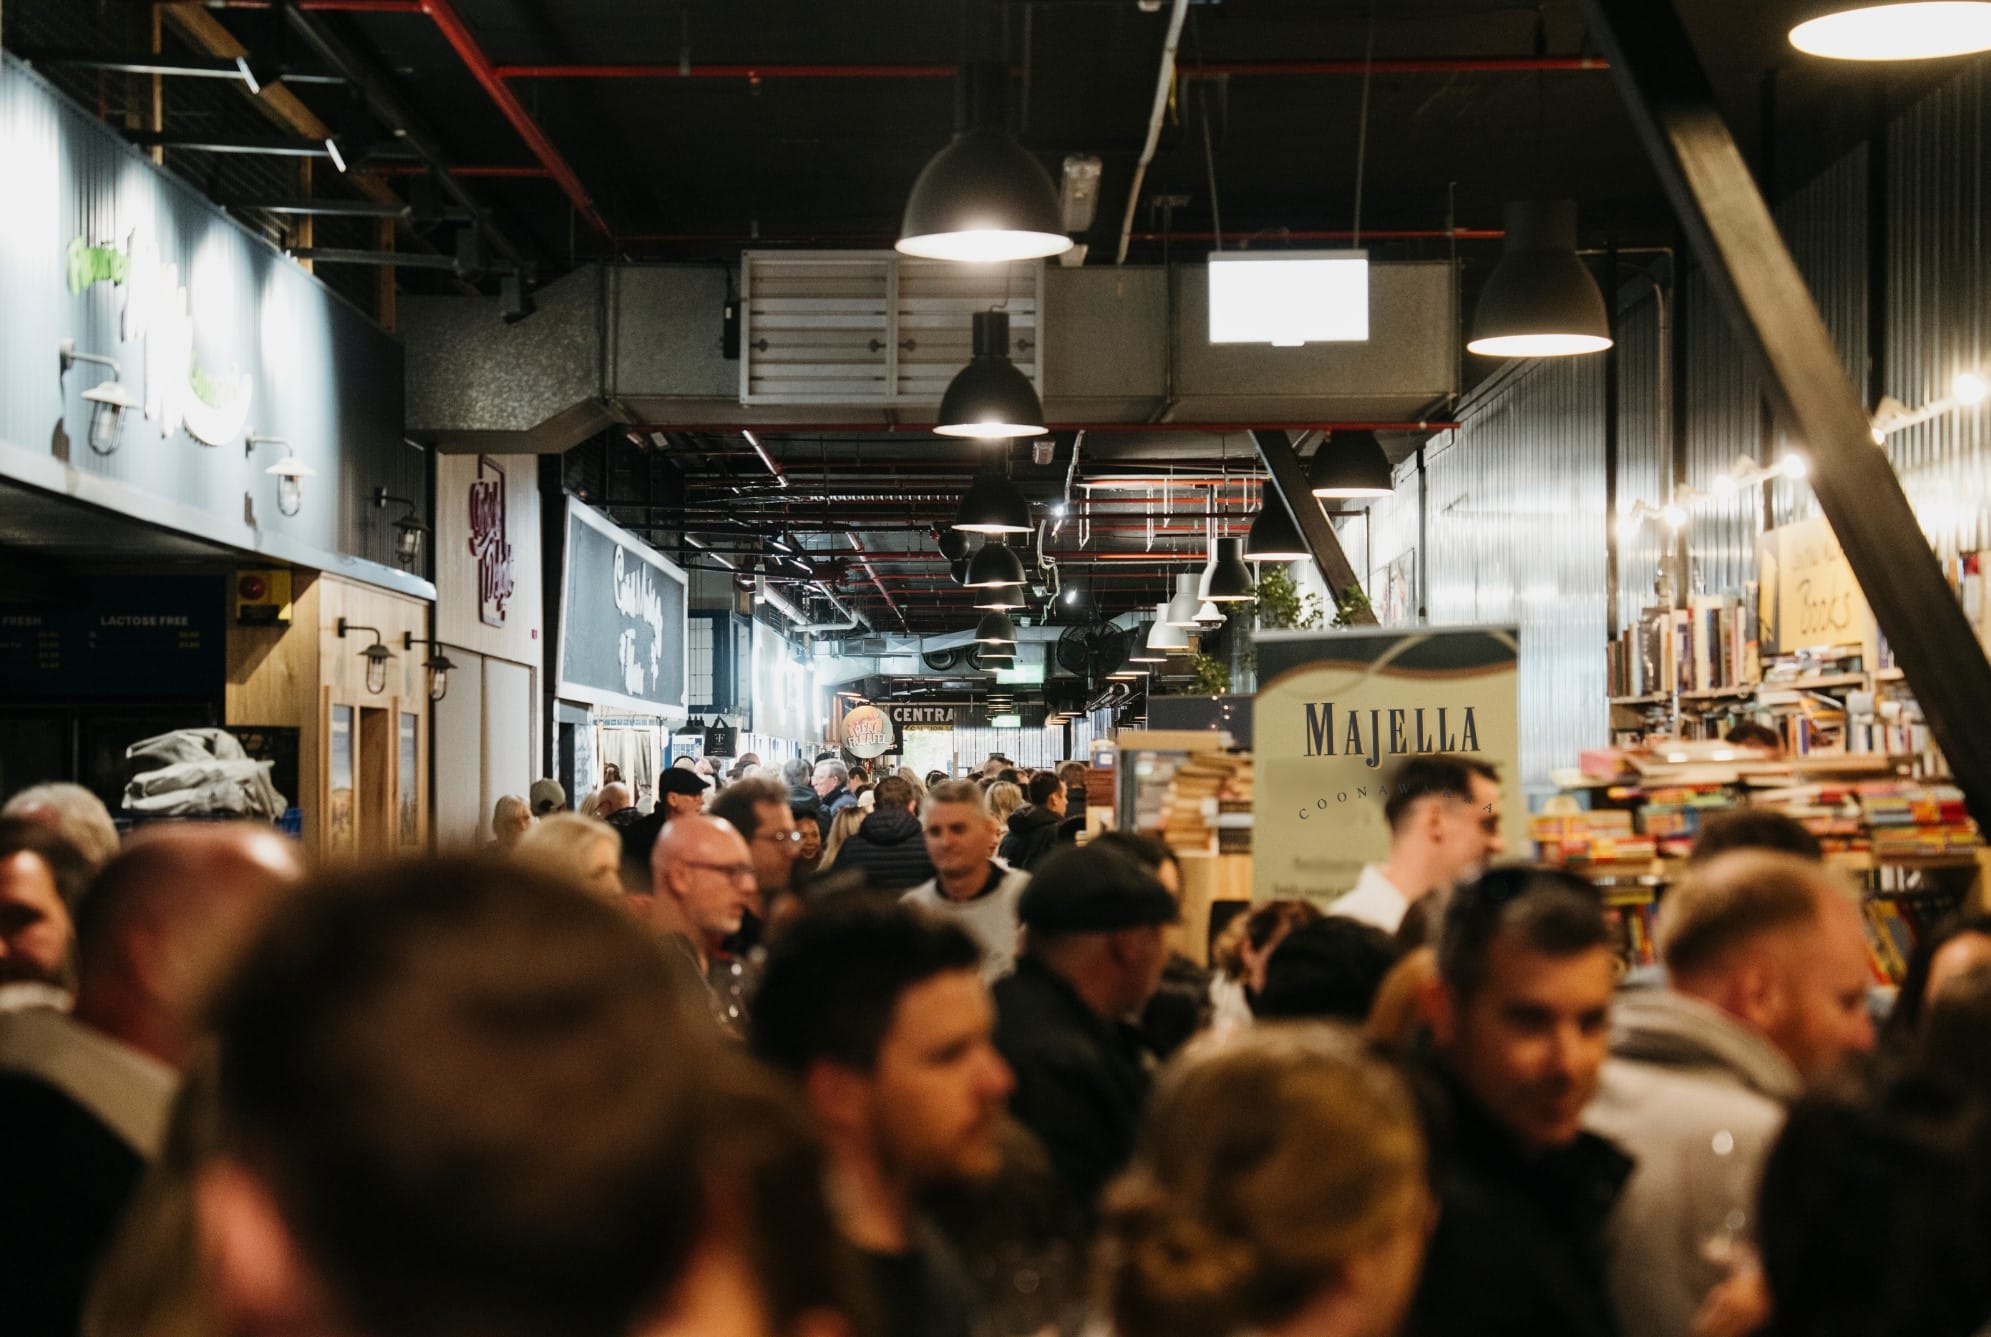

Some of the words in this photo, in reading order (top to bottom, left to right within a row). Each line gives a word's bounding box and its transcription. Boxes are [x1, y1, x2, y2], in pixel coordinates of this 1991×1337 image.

[100, 616, 156, 626] LACTOSE
[159, 616, 189, 626] FREE
[848, 732, 889, 748] FALAFEL
